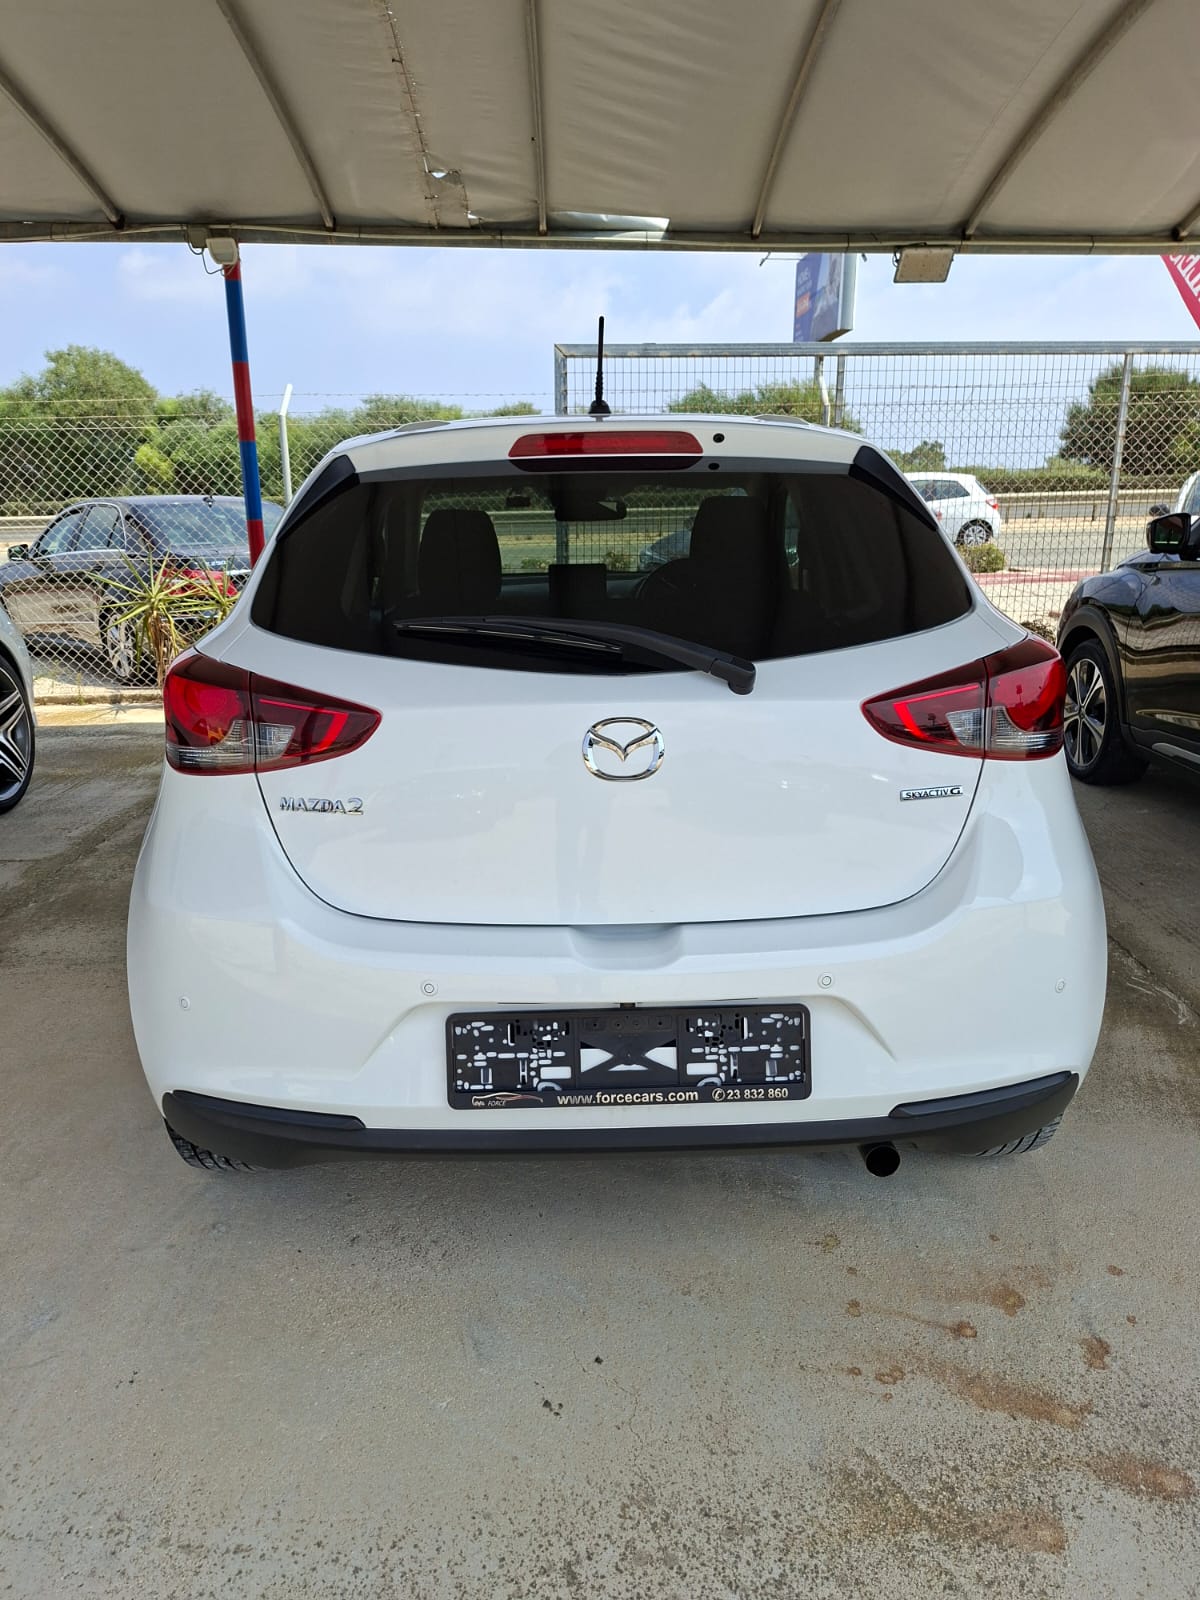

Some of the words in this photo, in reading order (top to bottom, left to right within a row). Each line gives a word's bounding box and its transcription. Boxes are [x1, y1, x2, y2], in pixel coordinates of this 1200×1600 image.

[557, 1091, 699, 1105] www.forcecars.com
[726, 1089, 741, 1100] 23
[744, 1088, 765, 1099] 832
[768, 1087, 789, 1099] 860
